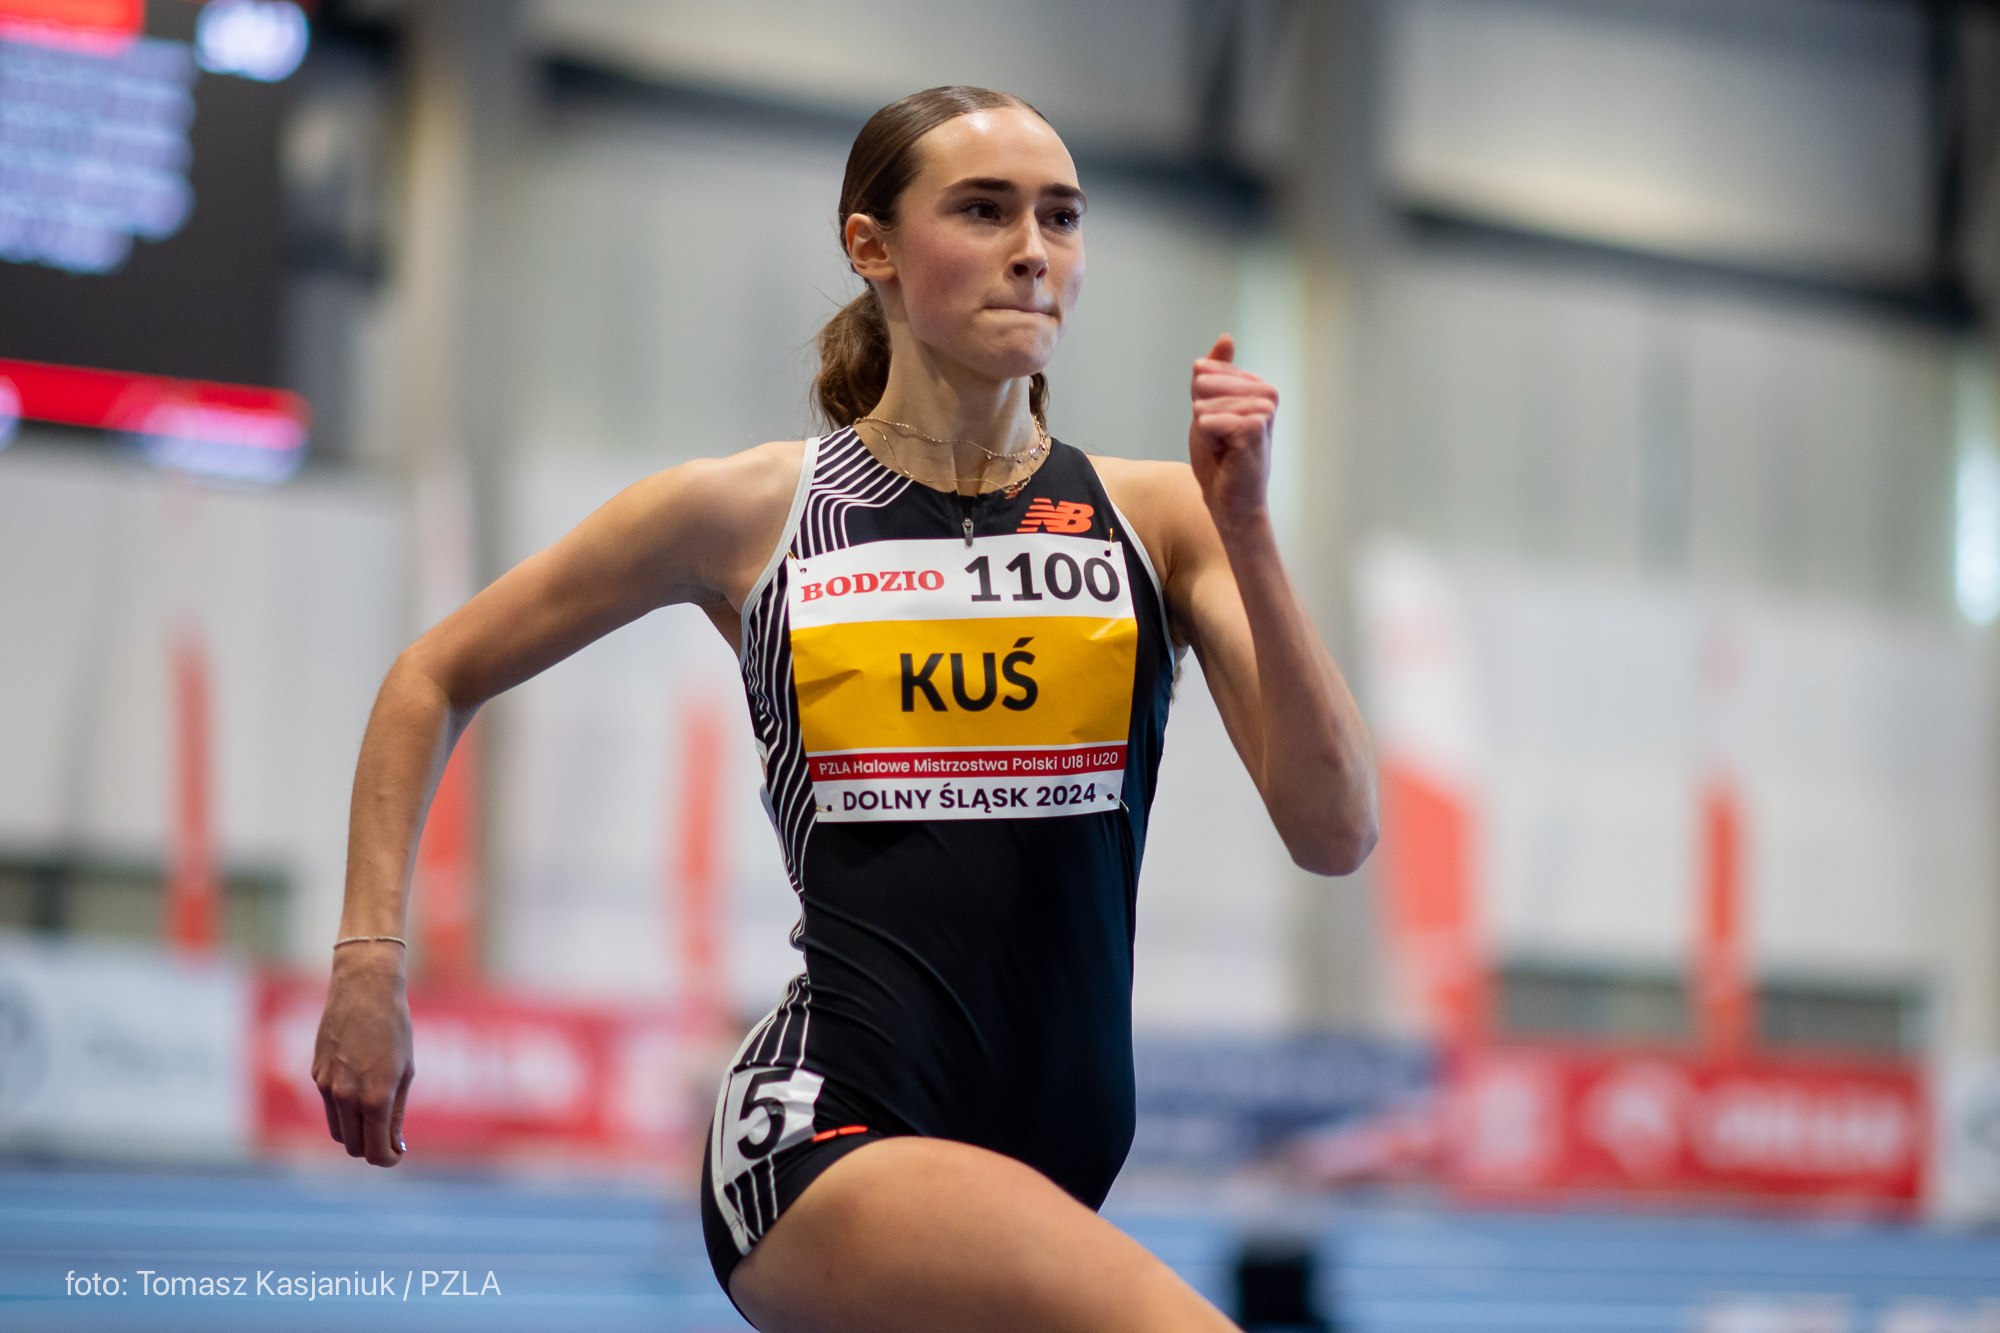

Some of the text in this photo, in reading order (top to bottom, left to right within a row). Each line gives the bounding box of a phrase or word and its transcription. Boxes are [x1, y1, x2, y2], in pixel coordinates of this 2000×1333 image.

[801, 569, 945, 603] BODZIO
[964, 552, 1120, 603] 1100
[899, 637, 1039, 712] KUŚ
[819, 751, 1119, 776] PZLA Halowe Mistrzostwa Polski U18 i U20
[843, 782, 1097, 813] DOLNY ŚLĄSK 2024
[737, 1067, 797, 1161] 5
